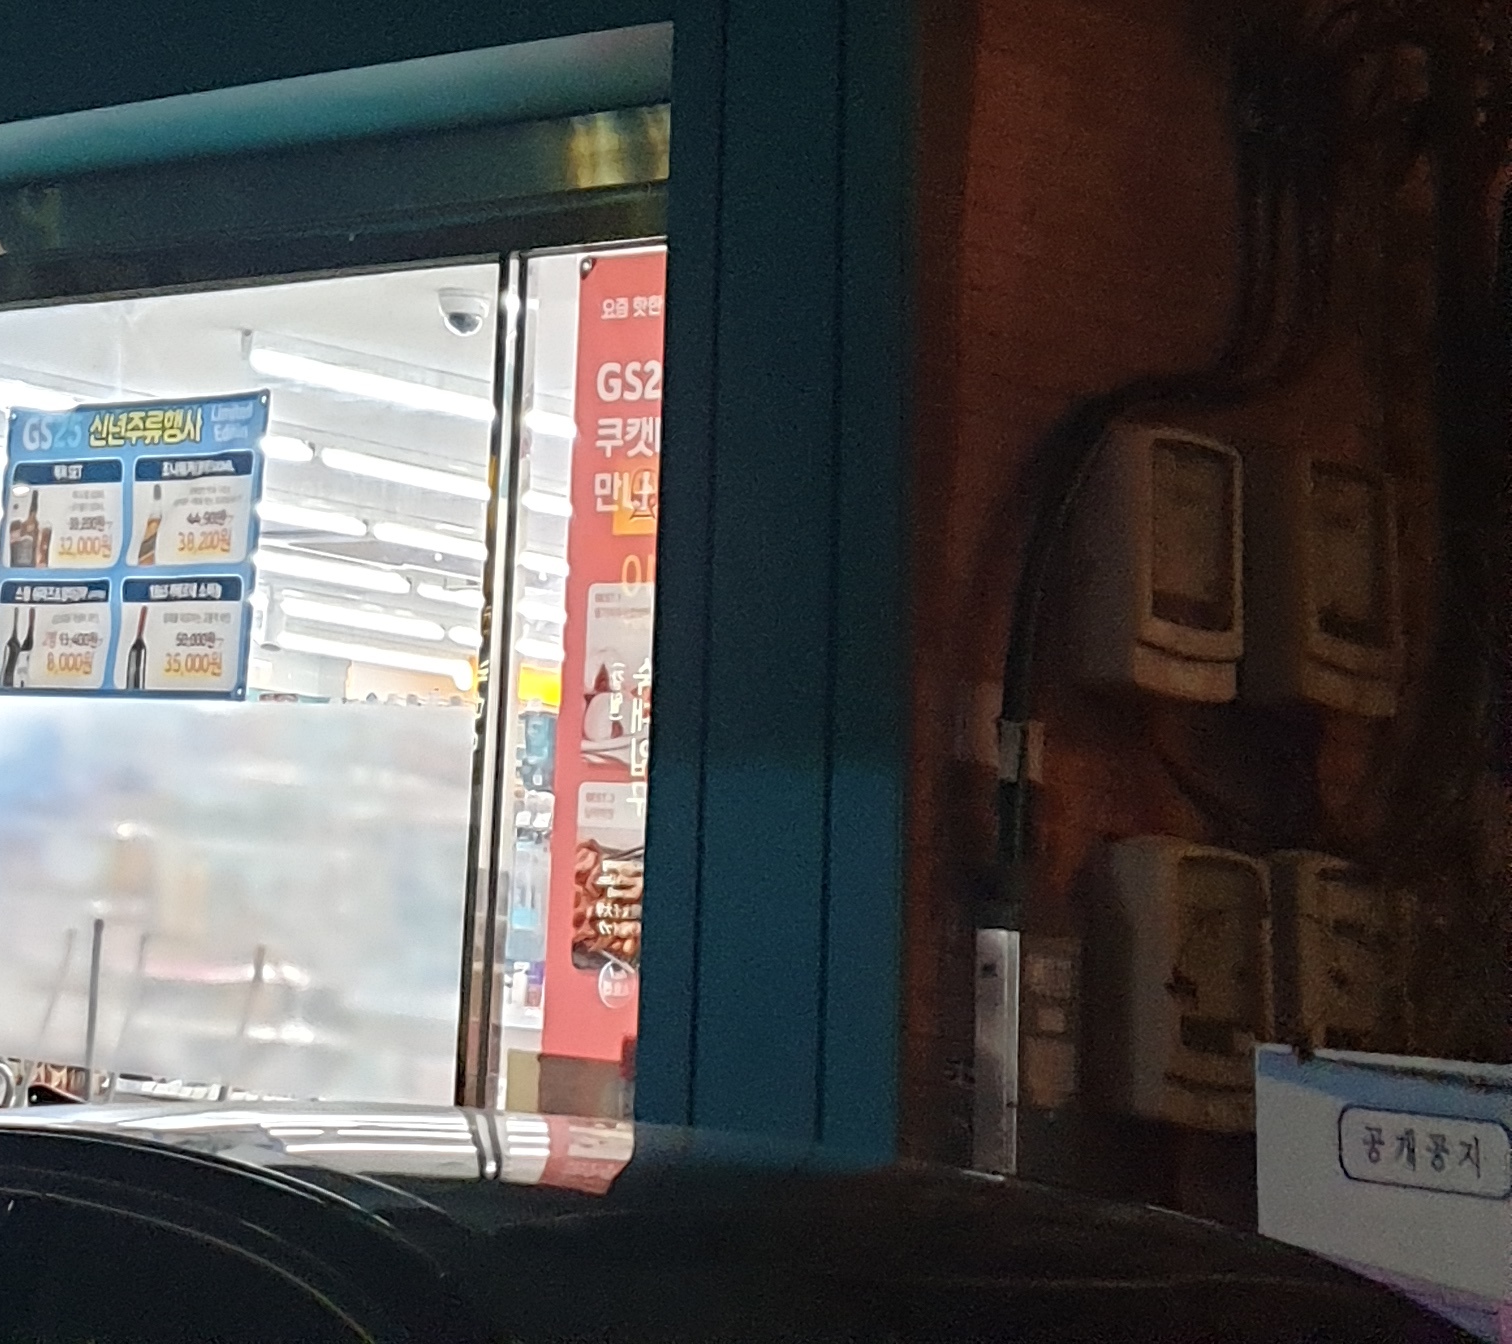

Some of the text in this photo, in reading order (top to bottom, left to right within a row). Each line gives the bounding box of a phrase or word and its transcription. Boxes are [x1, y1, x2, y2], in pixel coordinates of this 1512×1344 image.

[600, 295, 662, 320] 요즘 핫한
[23, 406, 204, 452] GS25 신년주류행사
[595, 416, 661, 458] 쿠캣
[1363, 1126, 1481, 1179] 공개공지
